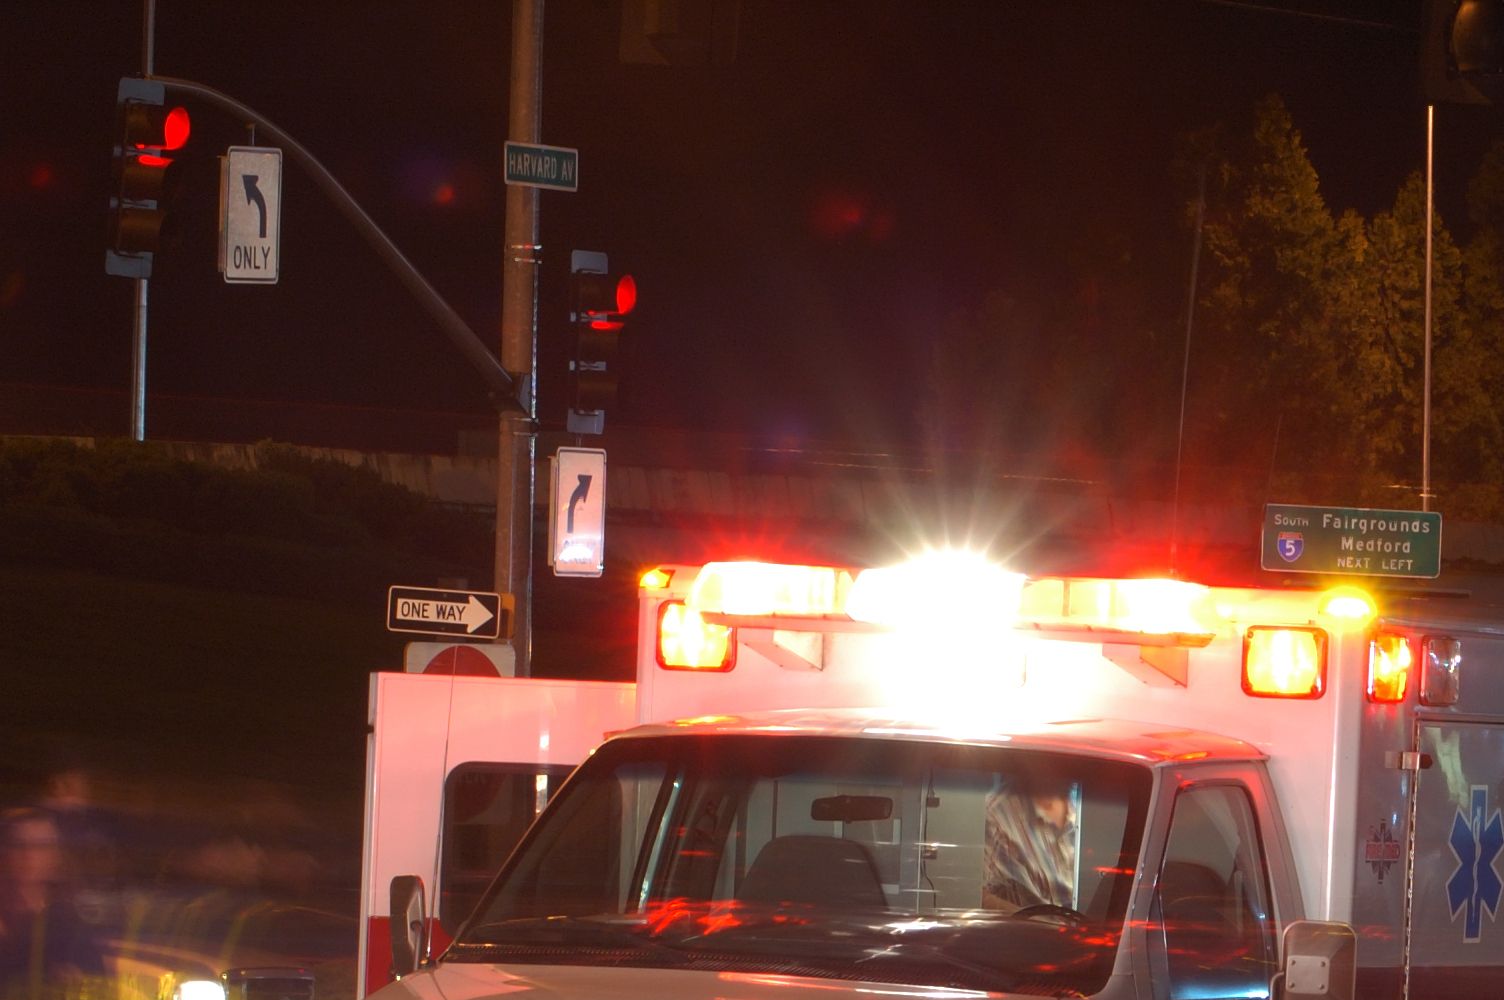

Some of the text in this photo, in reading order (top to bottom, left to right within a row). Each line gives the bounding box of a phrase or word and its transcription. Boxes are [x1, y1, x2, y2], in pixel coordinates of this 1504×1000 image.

[509, 152, 575, 181] HARVARD AV
[233, 245, 271, 270] ONLY
[1322, 513, 1431, 535] Fairgrounds
[1285, 536, 1412, 557] 5 Medford
[1337, 556, 1414, 572] NEXT LEFT
[401, 601, 466, 622] ONE WAY
